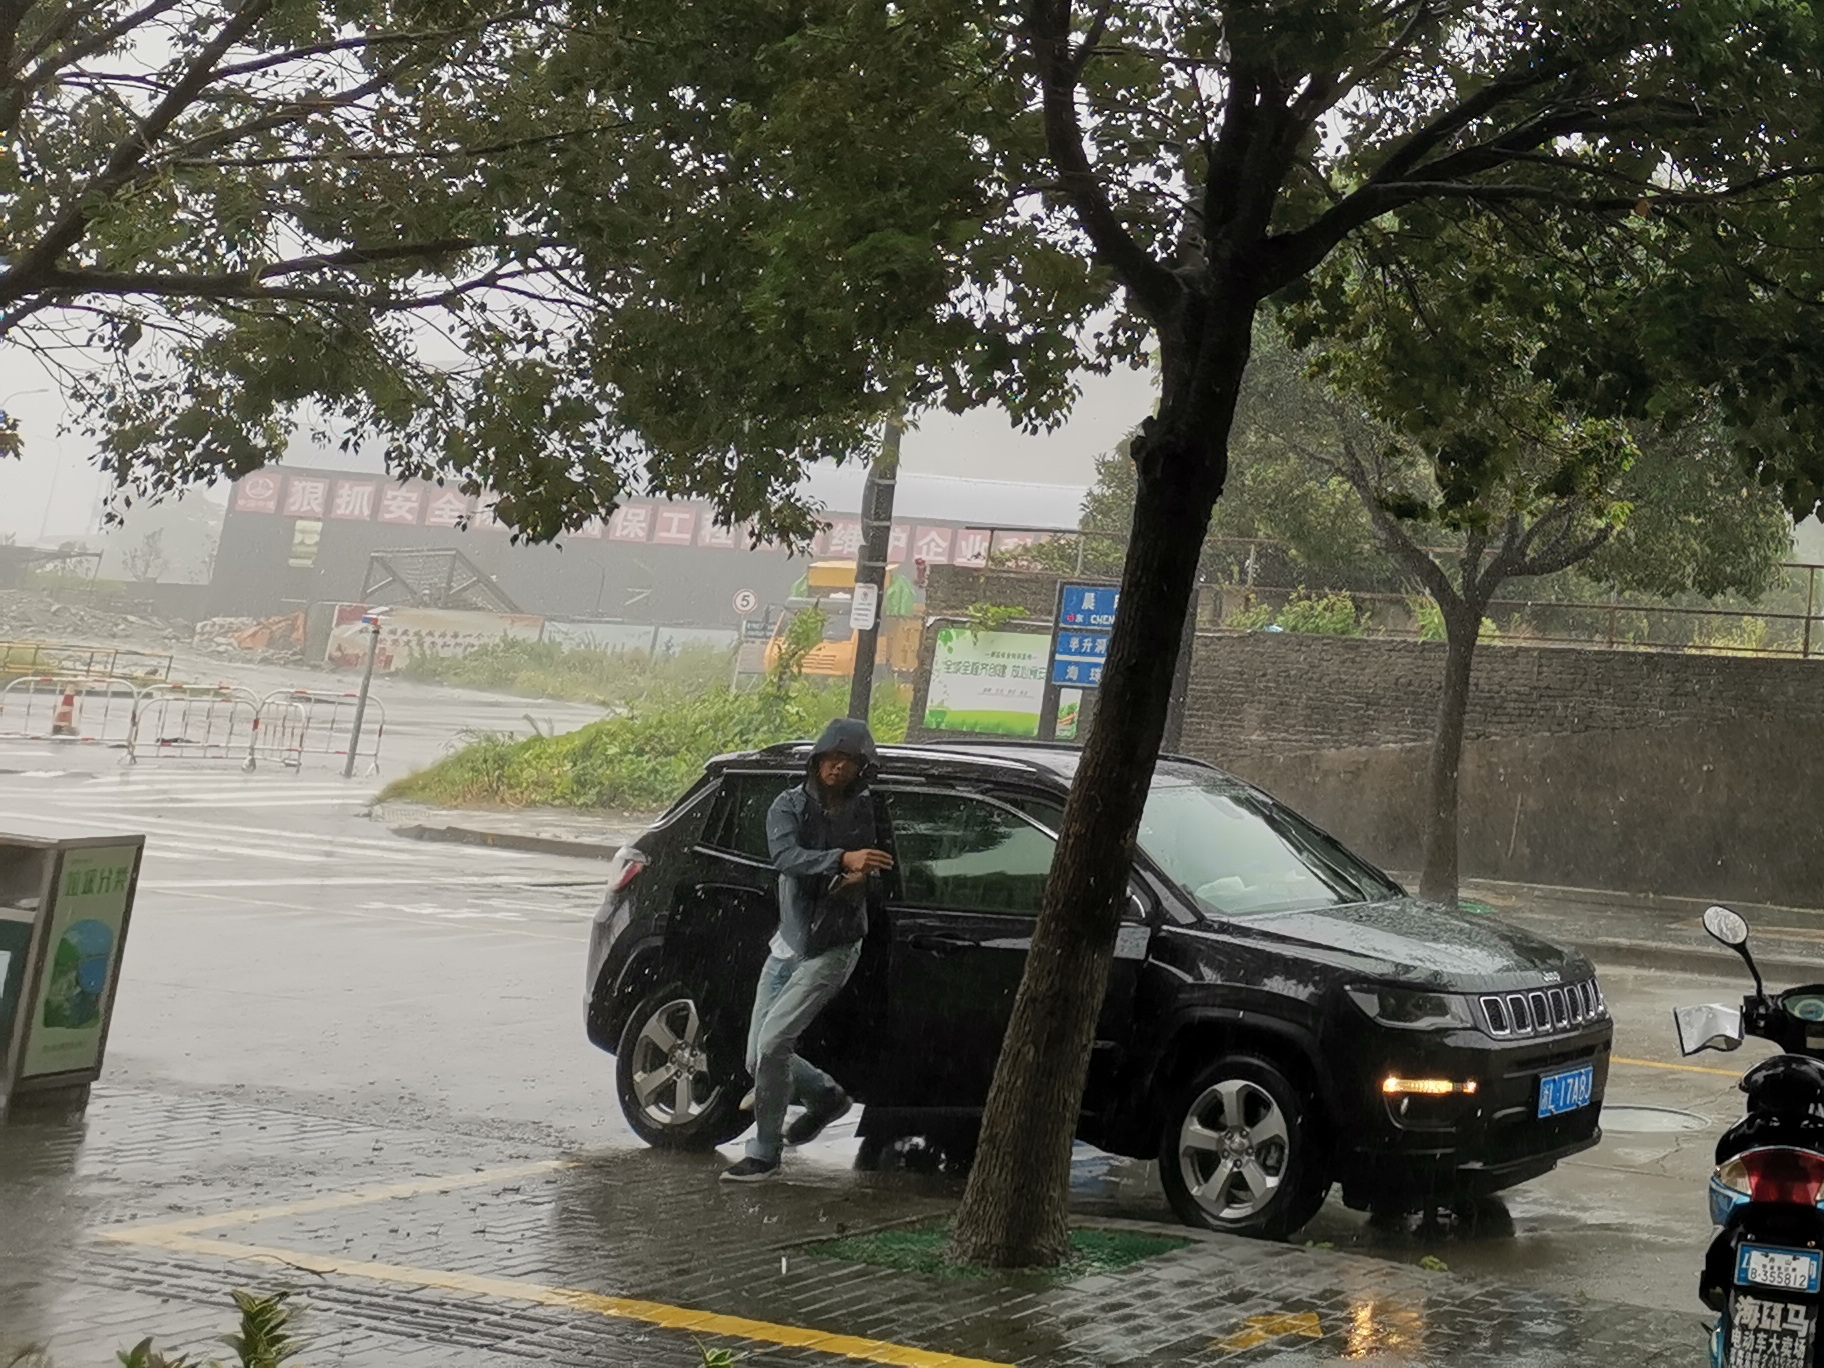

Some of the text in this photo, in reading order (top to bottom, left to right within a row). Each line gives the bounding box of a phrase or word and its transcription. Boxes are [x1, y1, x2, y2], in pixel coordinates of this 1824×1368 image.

[740, 594, 750, 608] 5
[1731, 1327, 1807, 1359] 电动车大卖场
